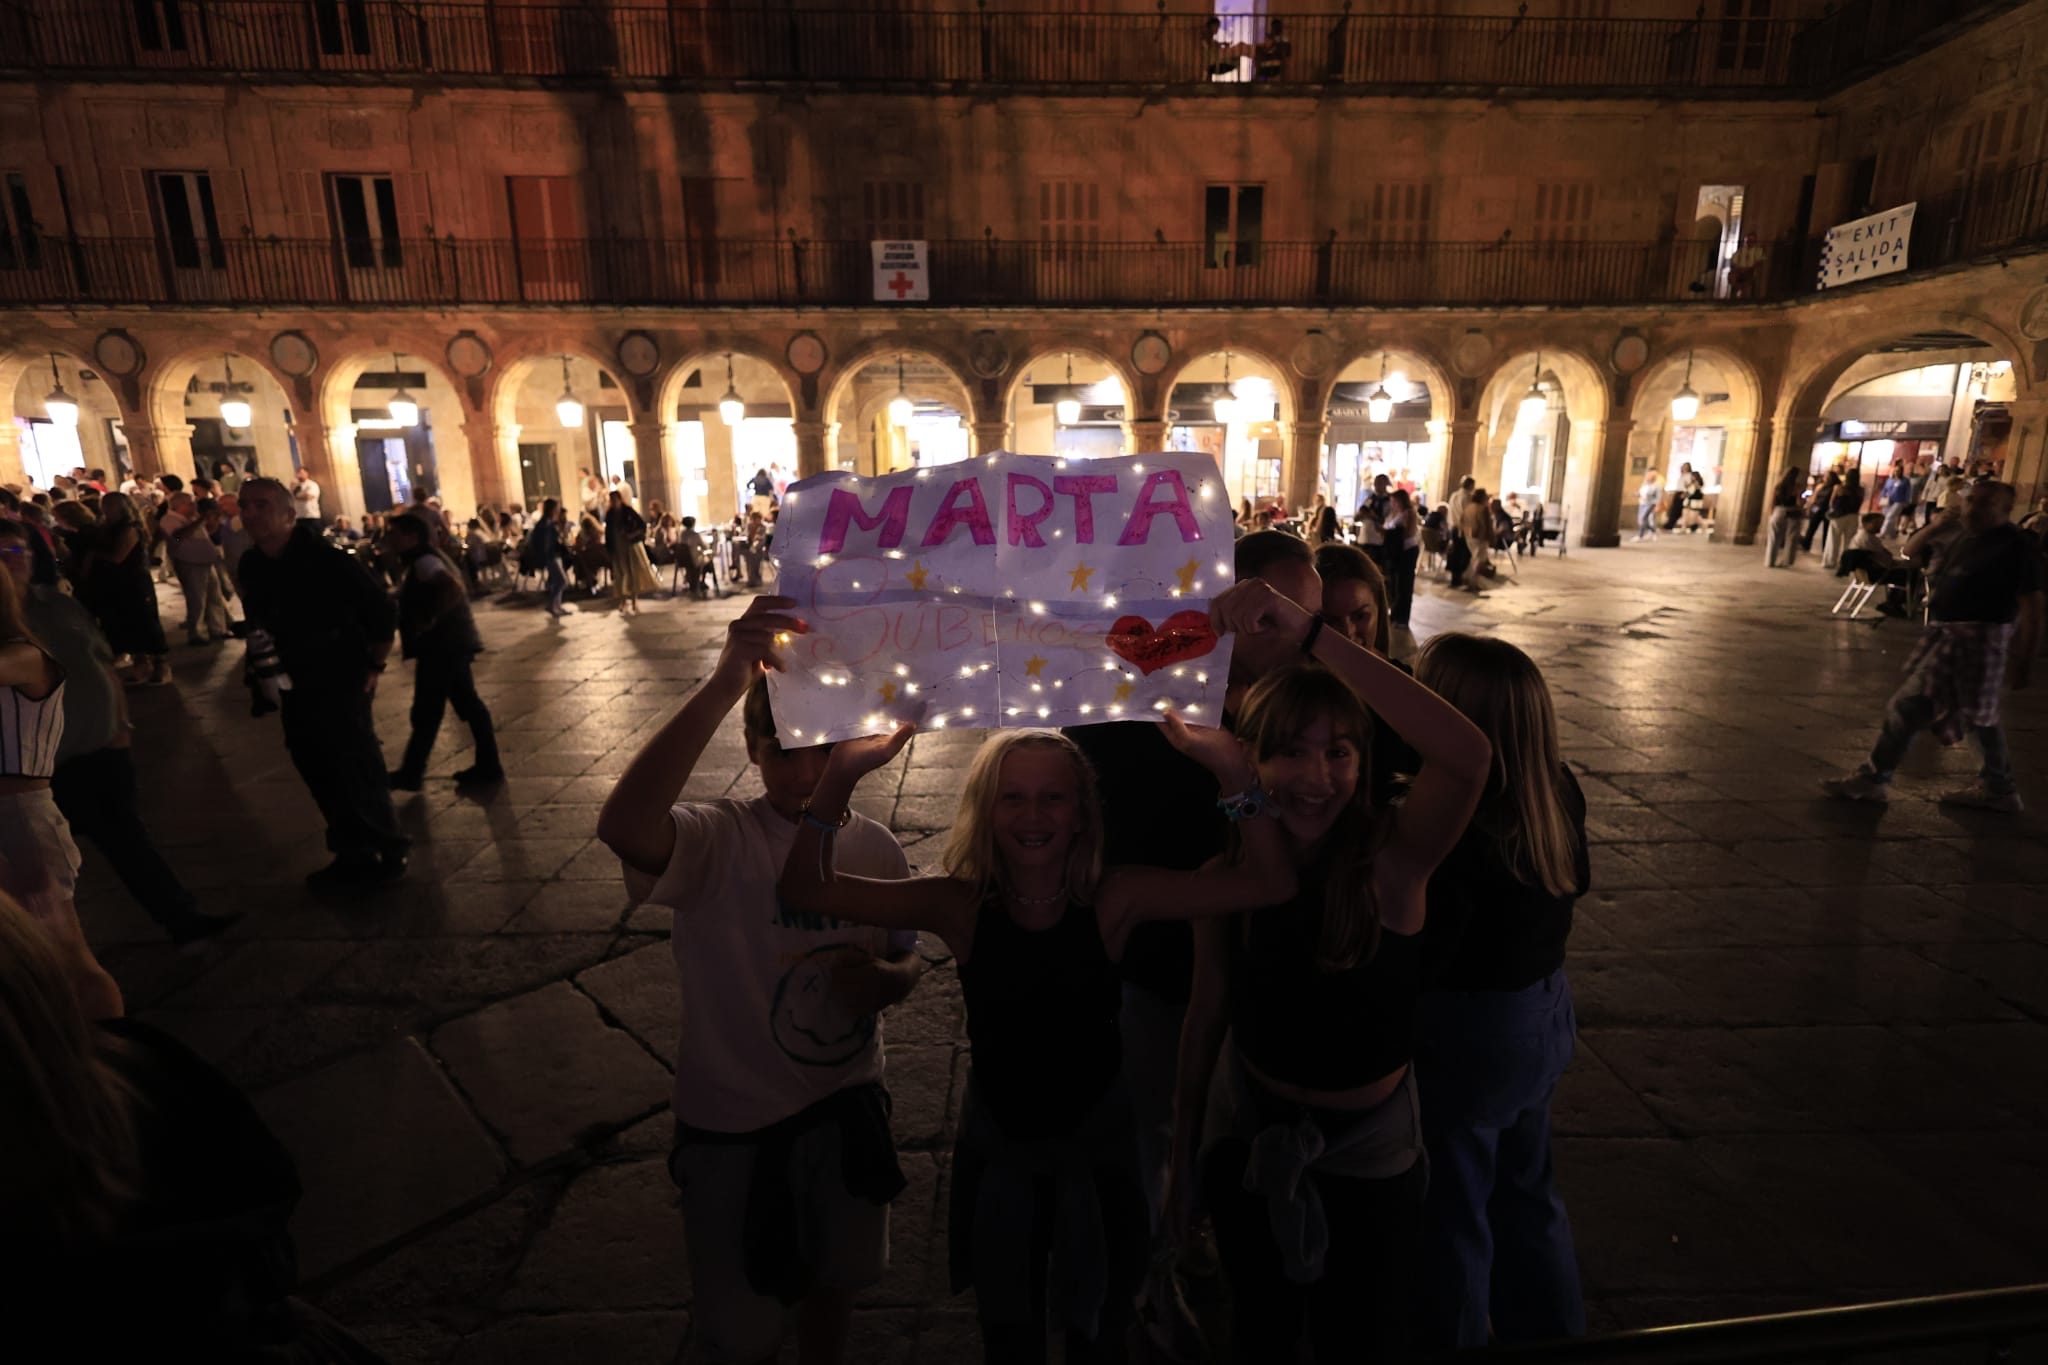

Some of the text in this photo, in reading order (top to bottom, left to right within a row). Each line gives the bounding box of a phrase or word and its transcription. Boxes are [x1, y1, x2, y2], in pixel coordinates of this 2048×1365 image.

[1853, 217, 1897, 242] EXIT
[1835, 237, 1904, 268] SALIDA
[818, 469, 1203, 554] MARTA
